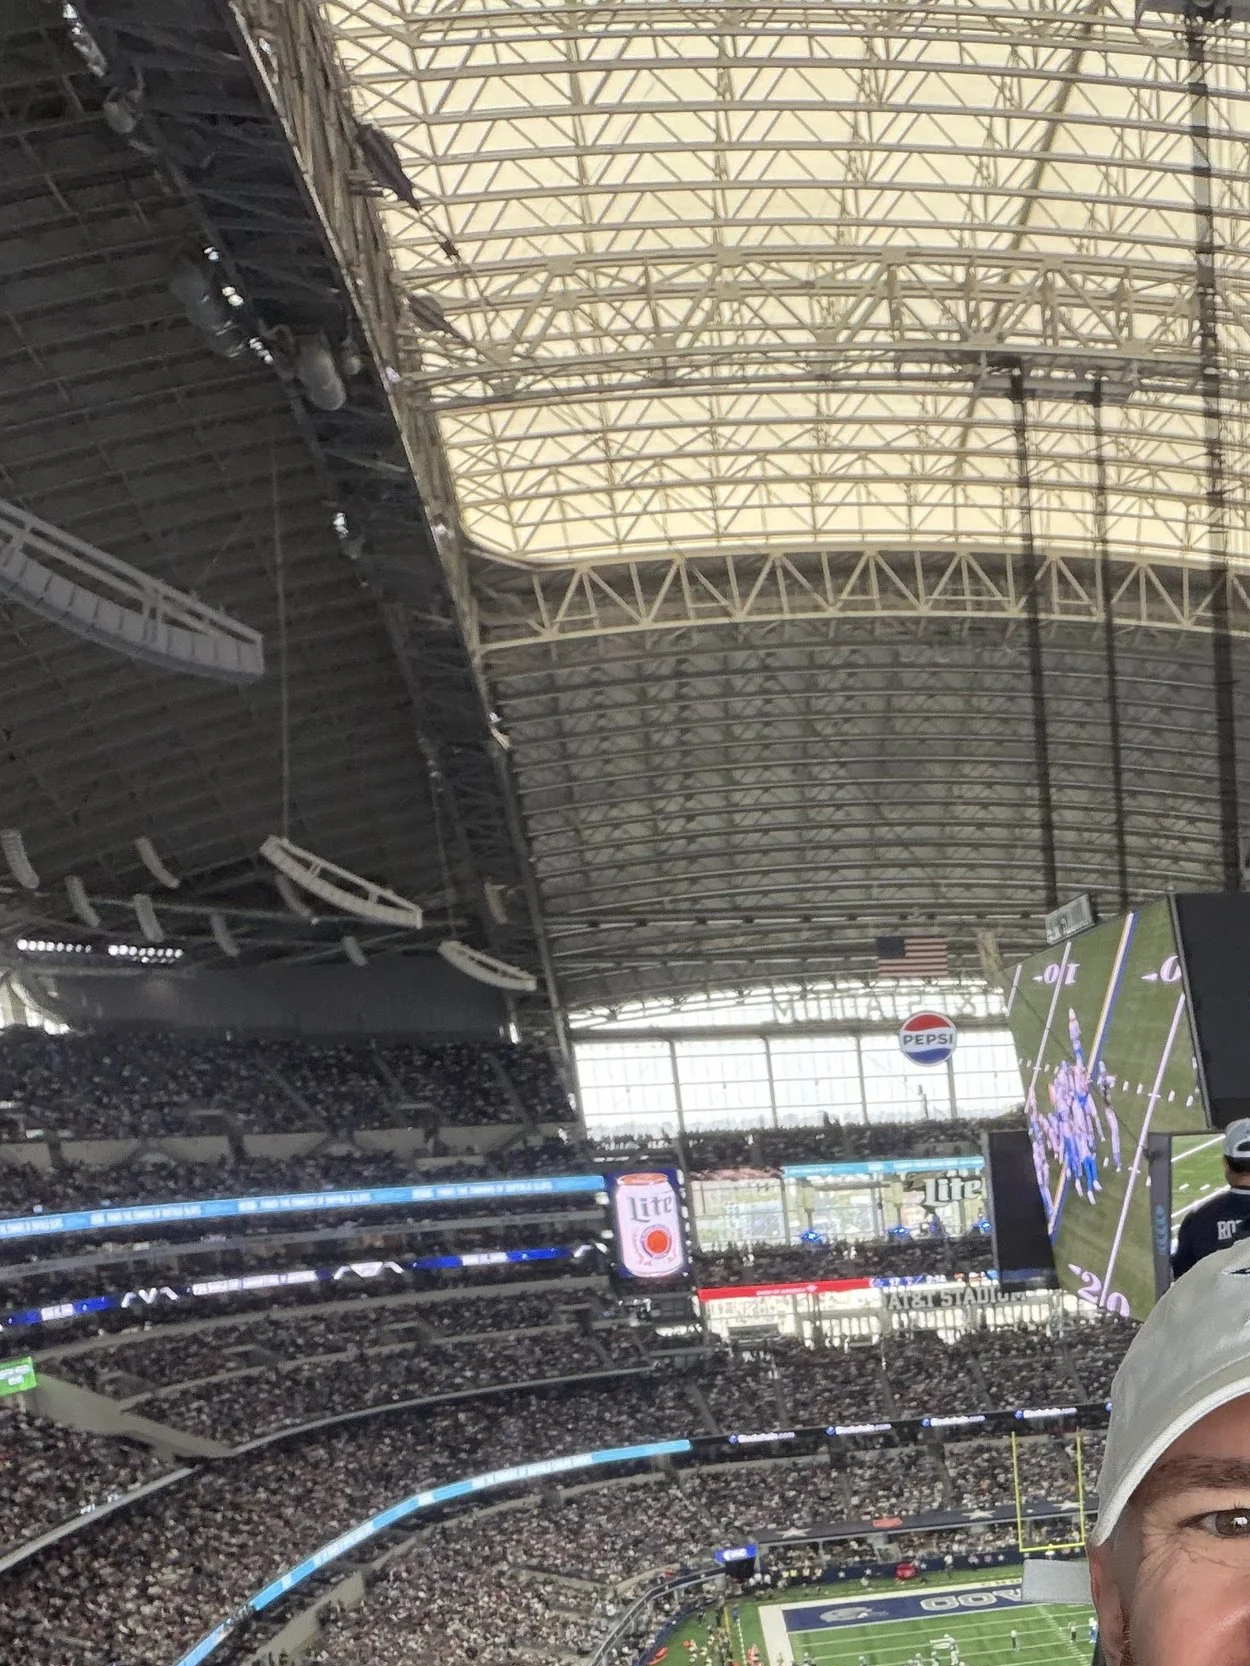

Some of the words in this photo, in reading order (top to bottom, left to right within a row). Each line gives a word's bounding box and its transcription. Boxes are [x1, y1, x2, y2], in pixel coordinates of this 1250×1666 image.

[903, 1033, 953, 1045] PEPSI
[924, 1177, 983, 1207] Lite
[628, 1196, 673, 1223] Lite
[888, 1289, 935, 1312] AT&T
